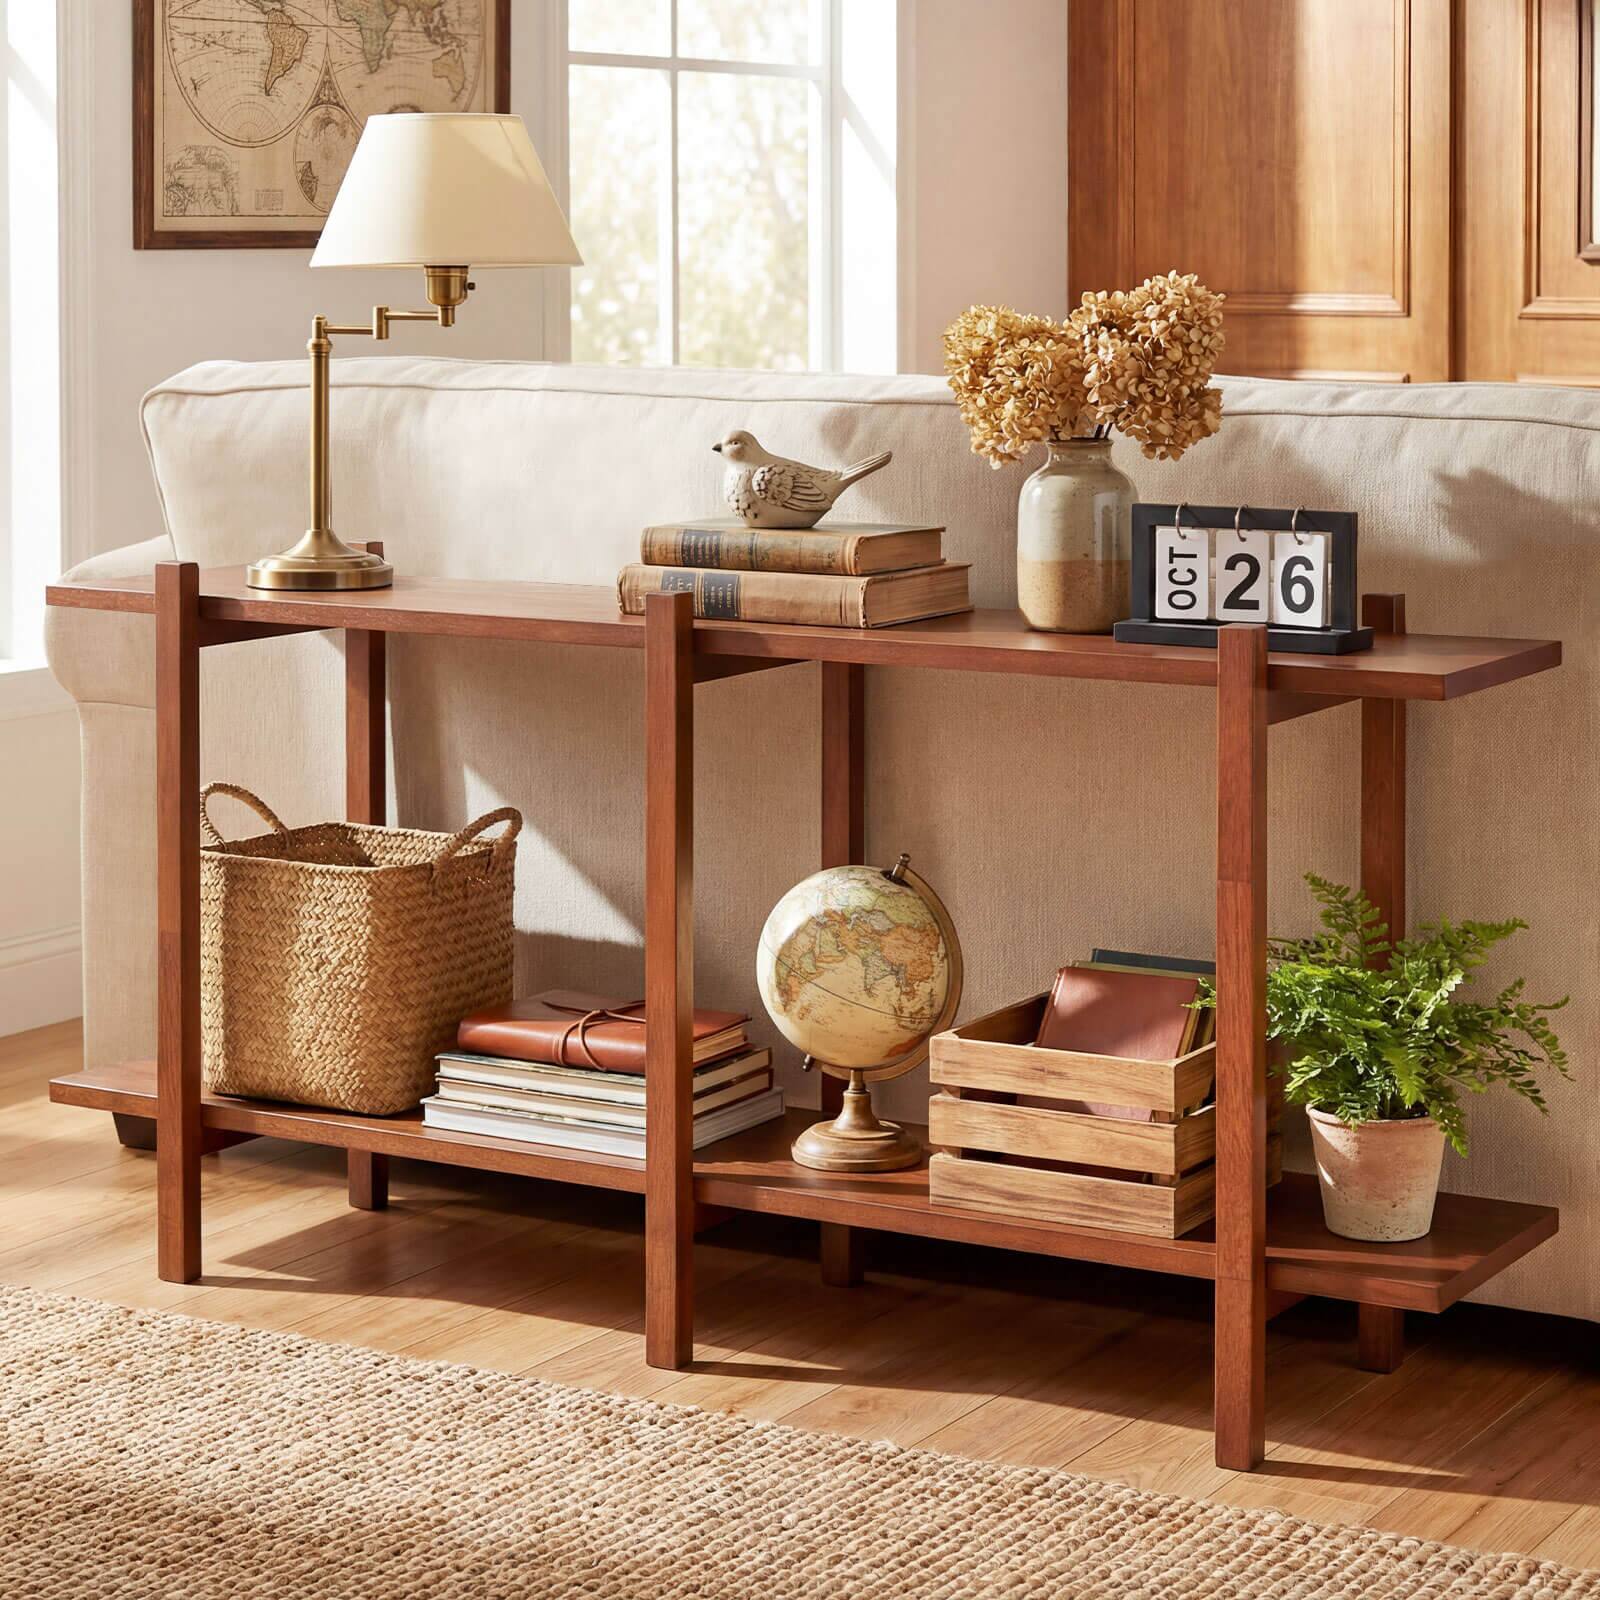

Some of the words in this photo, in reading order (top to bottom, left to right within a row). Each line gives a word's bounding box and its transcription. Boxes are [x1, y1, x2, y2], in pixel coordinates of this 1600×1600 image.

[1167, 546, 1198, 611] OCT
[1222, 552, 1261, 611] 2
[1280, 555, 1315, 614] 6
